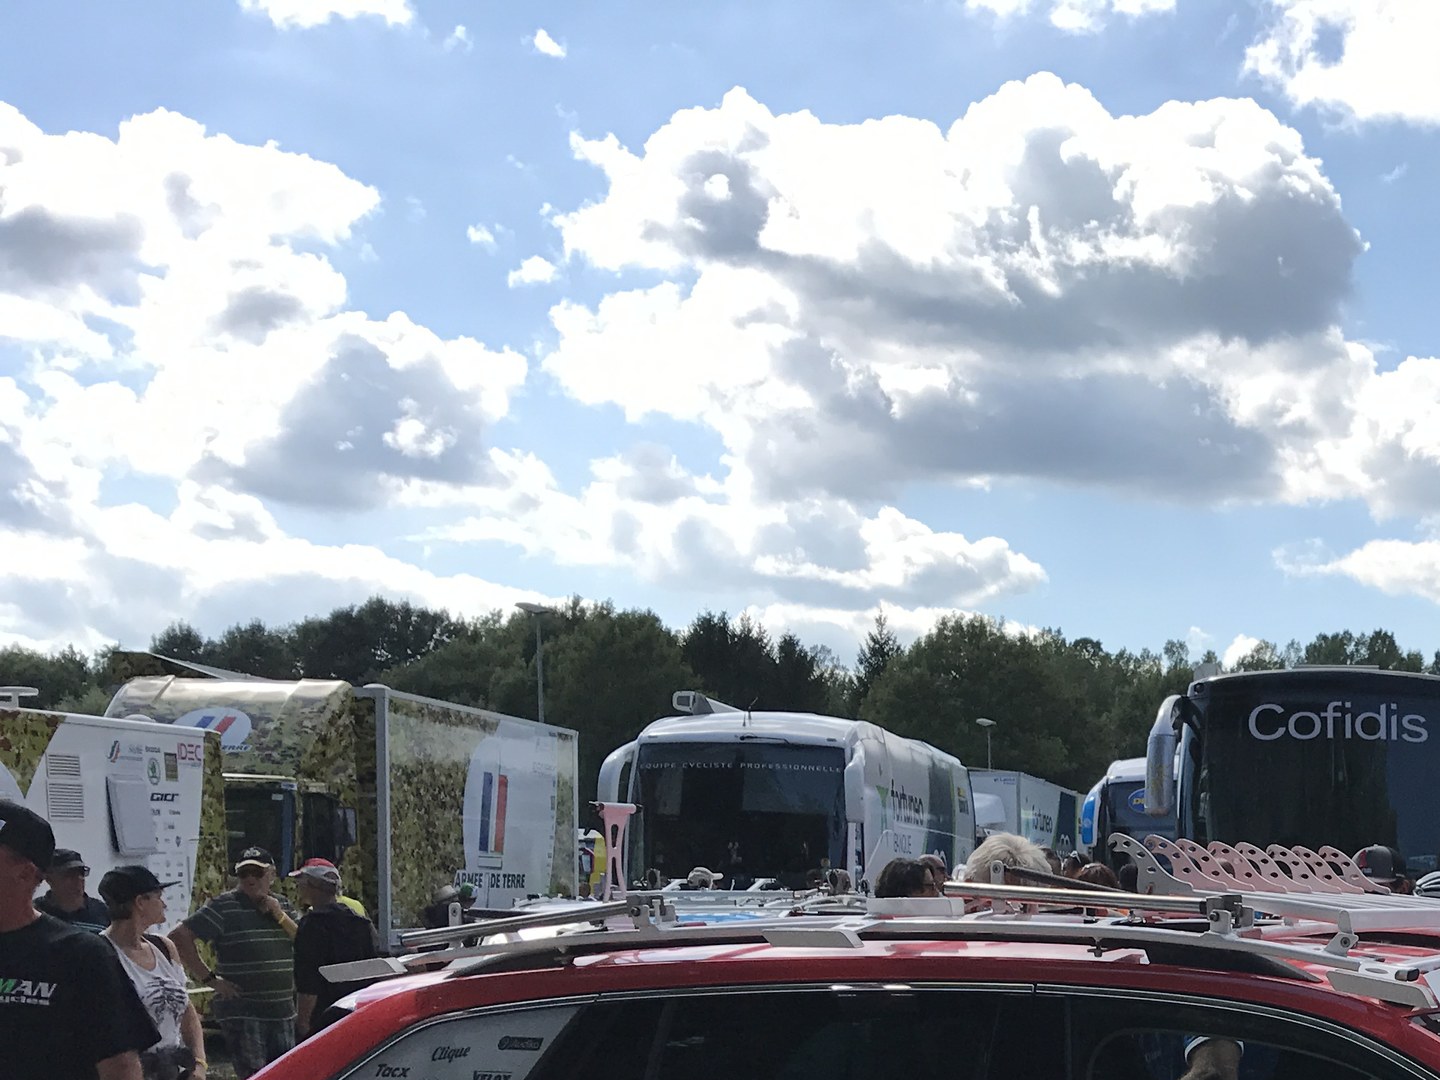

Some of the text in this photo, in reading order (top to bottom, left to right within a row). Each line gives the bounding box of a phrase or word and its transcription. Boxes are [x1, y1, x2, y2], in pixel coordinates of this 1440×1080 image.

[1248, 701, 1429, 743] Cofidis
[490, 872, 500, 888] DE
[502, 873, 526, 889] TERRE
[432, 1046, 471, 1063] Clique
[375, 1064, 411, 1078] Tacx
